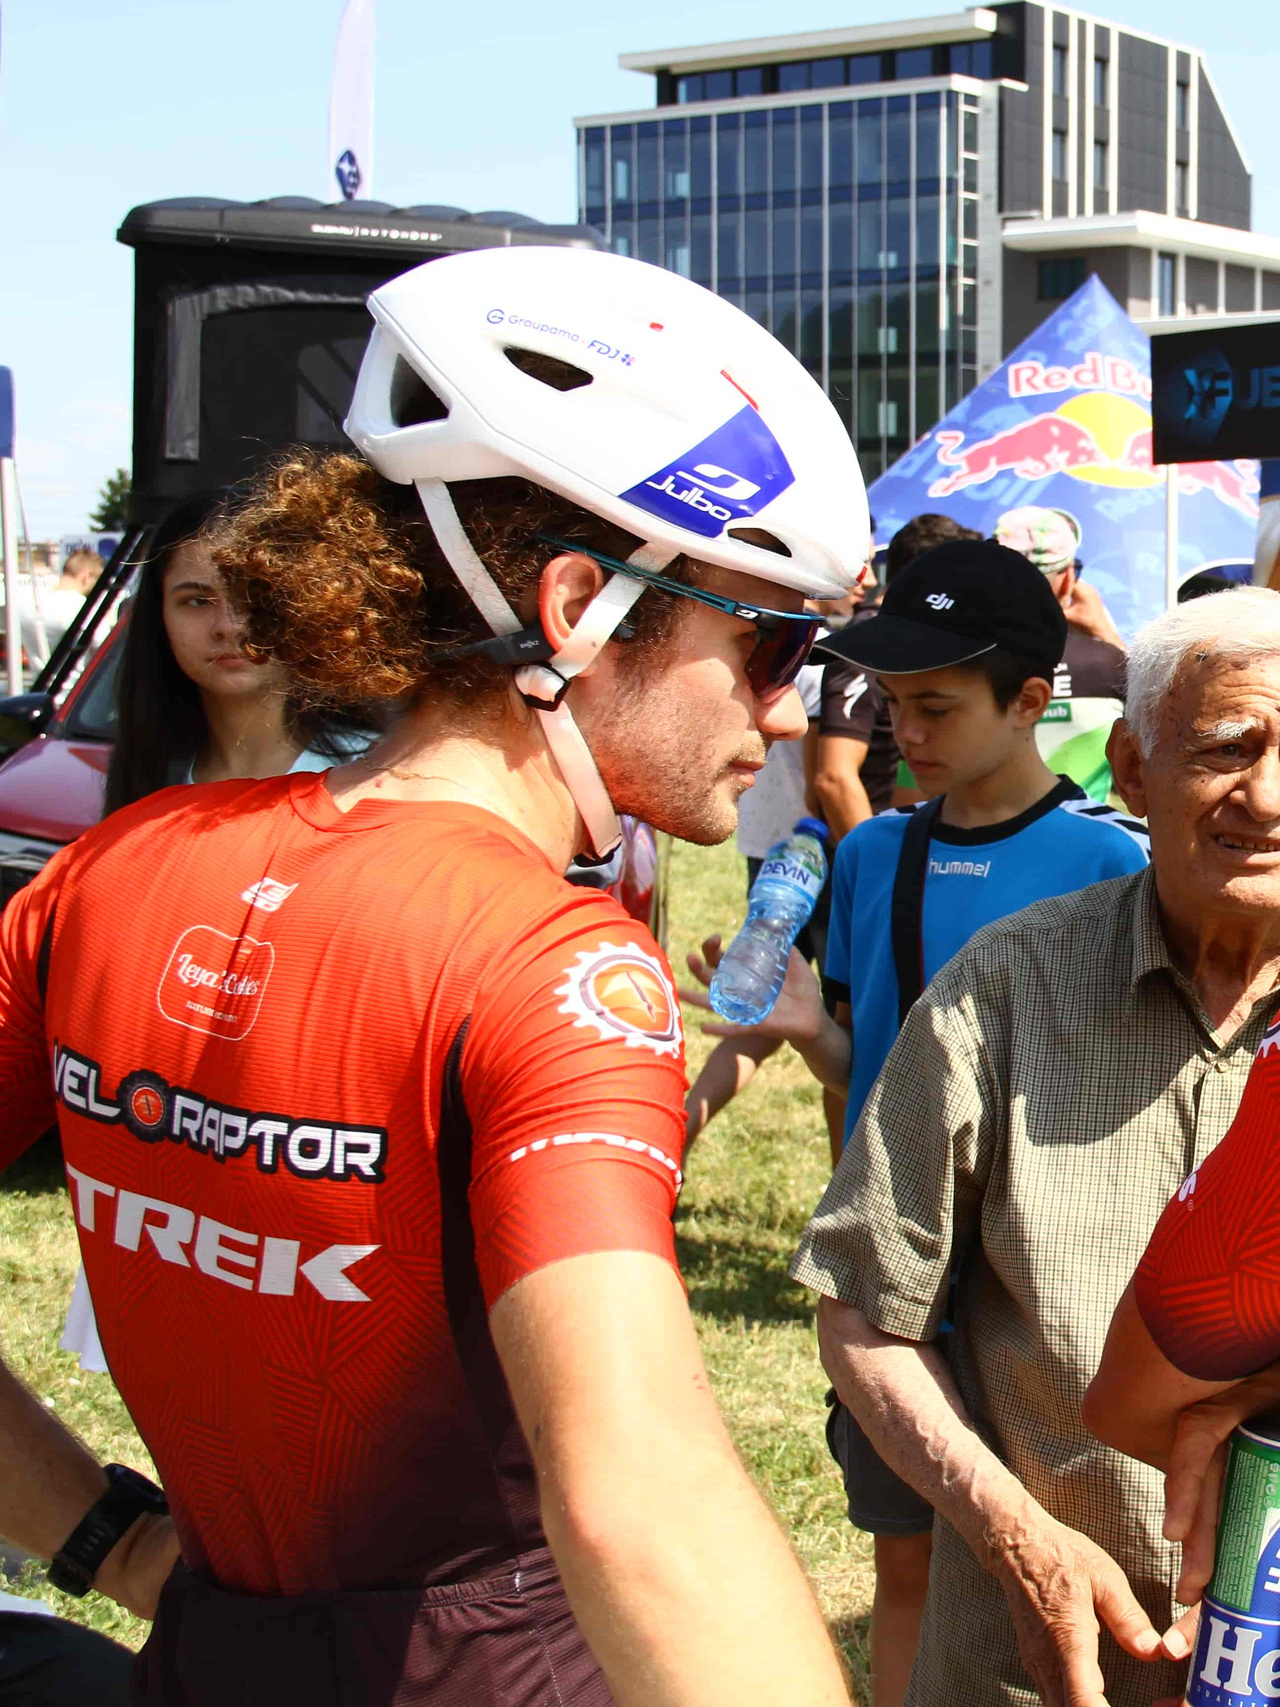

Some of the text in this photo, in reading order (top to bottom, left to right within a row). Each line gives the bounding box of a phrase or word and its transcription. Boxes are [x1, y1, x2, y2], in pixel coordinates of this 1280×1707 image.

[507, 314, 580, 343] Groupama
[587, 339, 621, 359] FDJ
[1008, 352, 1102, 398] Red
[645, 474, 732, 522] Julbo
[762, 862, 811, 886] DEVIN
[928, 860, 992, 878] hummel
[65, 1161, 383, 1303] TREK
